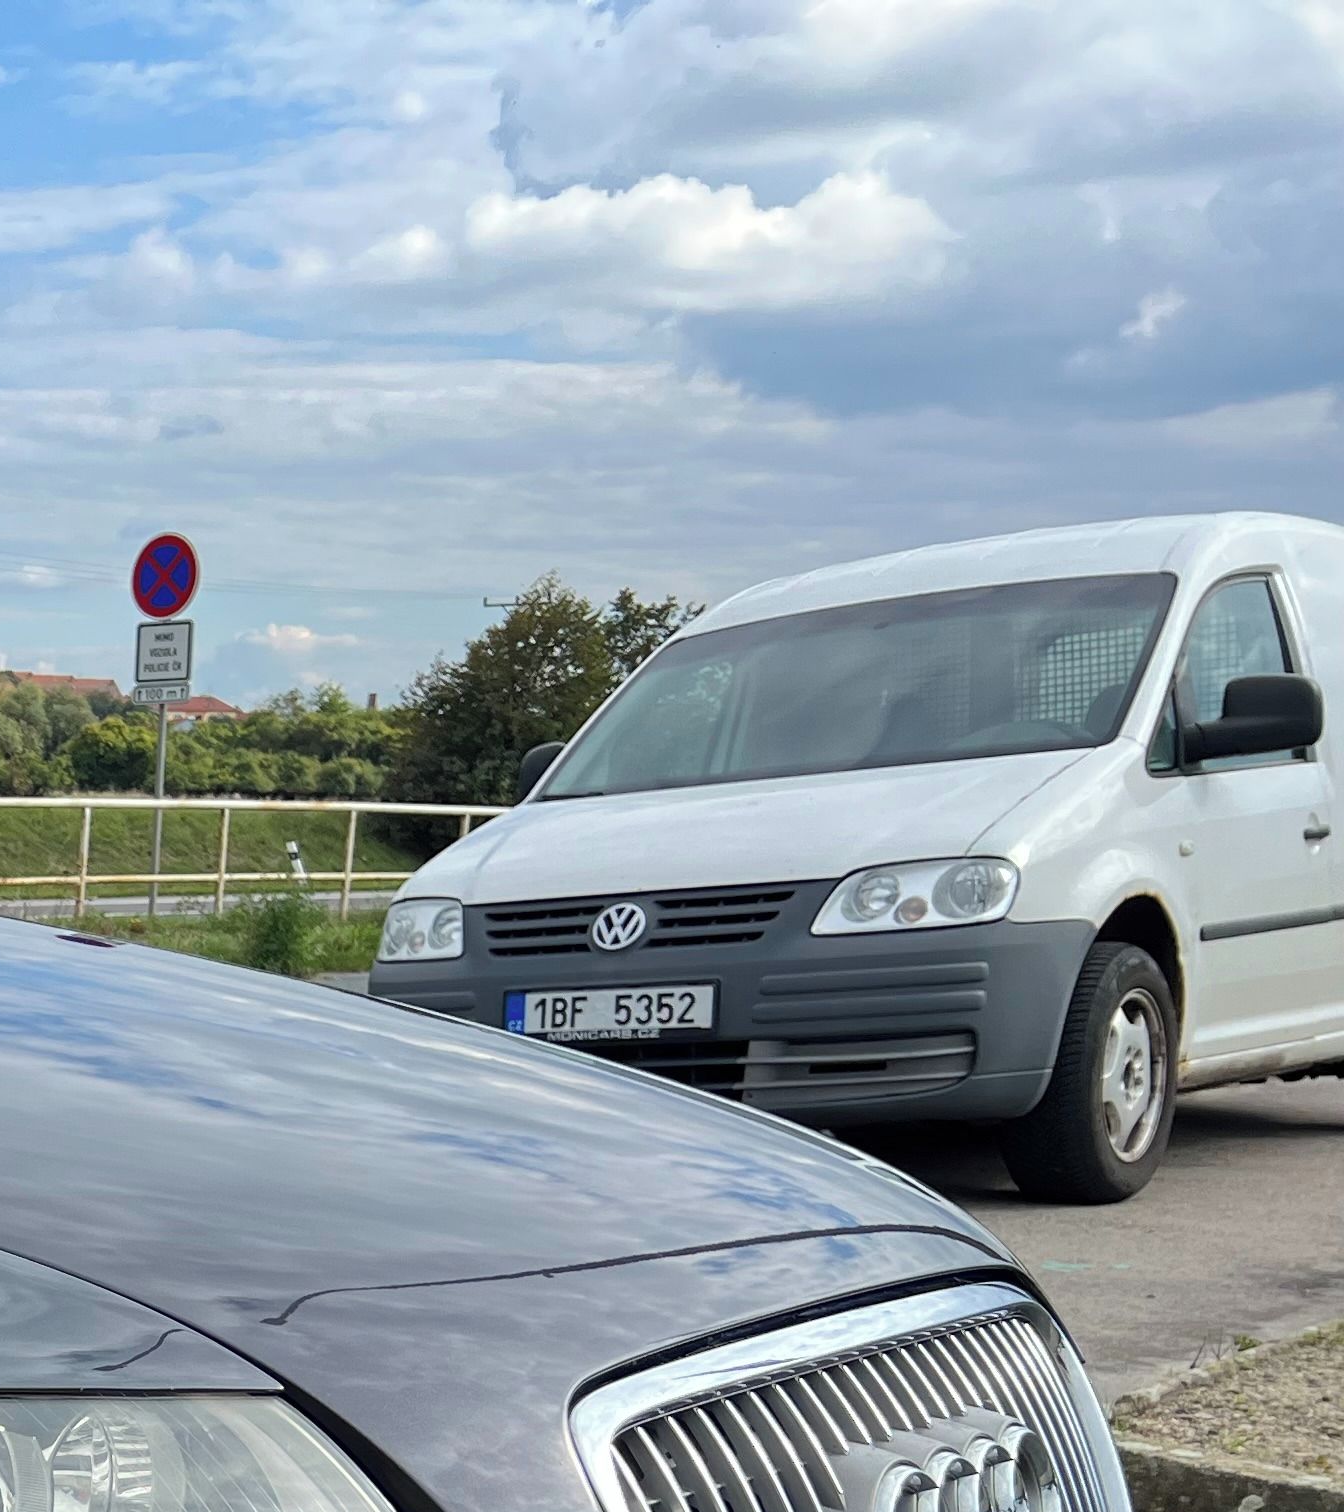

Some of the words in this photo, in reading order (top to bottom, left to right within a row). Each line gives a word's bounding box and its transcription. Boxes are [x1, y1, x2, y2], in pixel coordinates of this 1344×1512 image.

[145, 688, 163, 699] 100
[166, 690, 177, 699] m
[534, 996, 588, 1028] 1BF
[614, 992, 696, 1026] 5352
